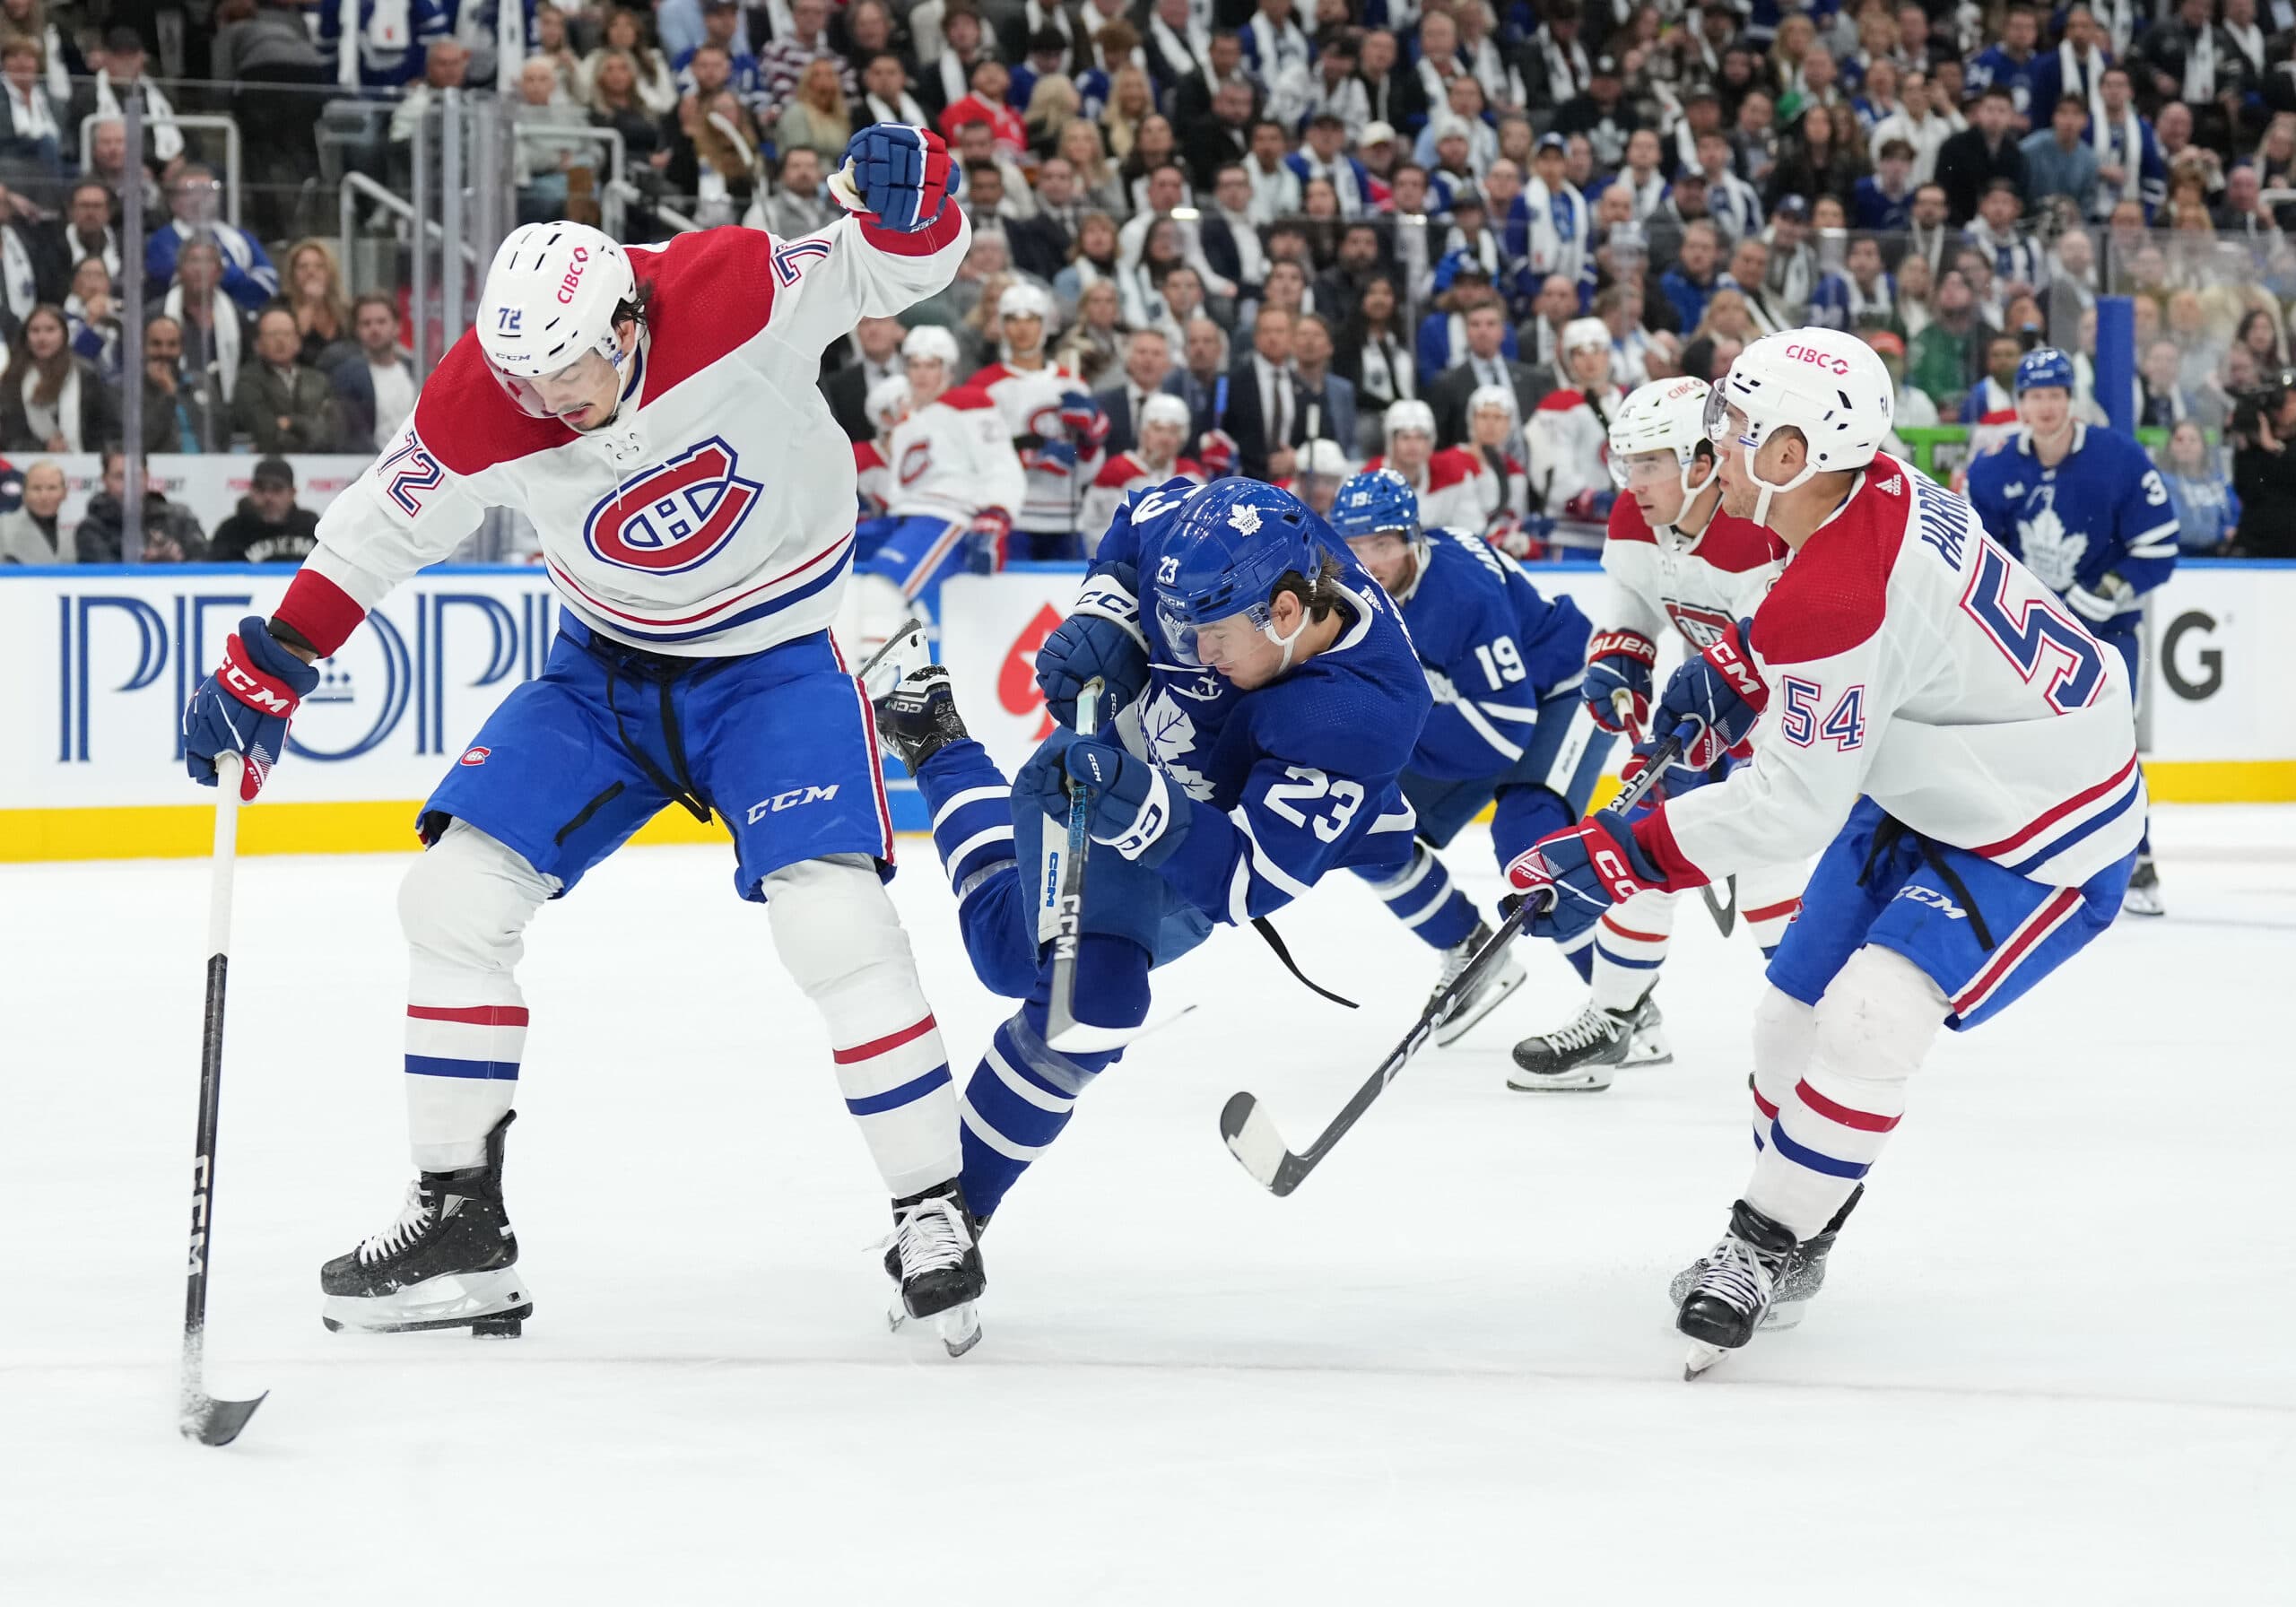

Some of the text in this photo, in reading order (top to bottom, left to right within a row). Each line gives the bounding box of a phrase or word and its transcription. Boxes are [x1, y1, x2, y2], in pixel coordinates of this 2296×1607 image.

[557, 262, 584, 304] CIBC
[498, 307, 522, 330] 72
[495, 352, 531, 361] CCM
[1786, 344, 1830, 368] CIBC
[1668, 382, 1693, 399] CIBC
[377, 429, 445, 517] 72
[1350, 491, 1369, 508] 19
[1158, 555, 1179, 584] 23
[1161, 594, 1186, 608] CCM
[1474, 635, 1526, 691] 19
[1109, 691, 1118, 721] CCM
[1781, 674, 1866, 752] 54
[1086, 752, 1102, 783] CCM
[745, 783, 840, 826] CCM
[1263, 765, 1365, 845] 23
[1046, 851, 1059, 908] CCM
[1516, 866, 1542, 882] CCM
[1053, 894, 1081, 960] CCM
[187, 1153, 210, 1278] CCM
